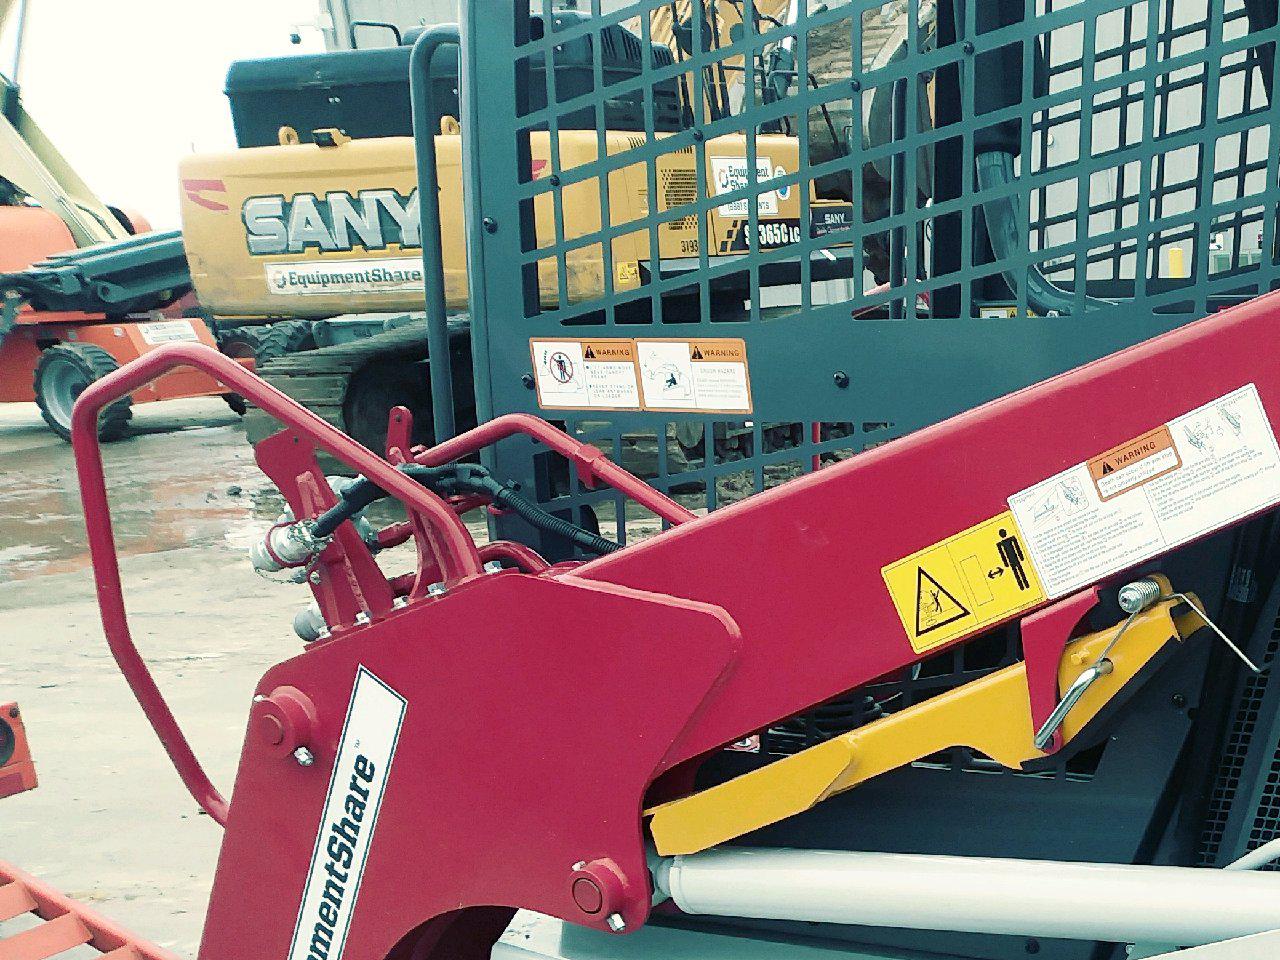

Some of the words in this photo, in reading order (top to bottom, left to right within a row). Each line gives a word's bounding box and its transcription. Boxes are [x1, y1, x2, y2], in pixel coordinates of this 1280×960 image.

[727, 165, 769, 180] Equipent
[243, 187, 421, 255] SANY
[824, 212, 845, 225] SANY
[744, 223, 788, 246] S365C
[288, 267, 422, 290] EquipmentShare
[703, 349, 740, 357] WARNING
[1114, 441, 1156, 466] WARNING
